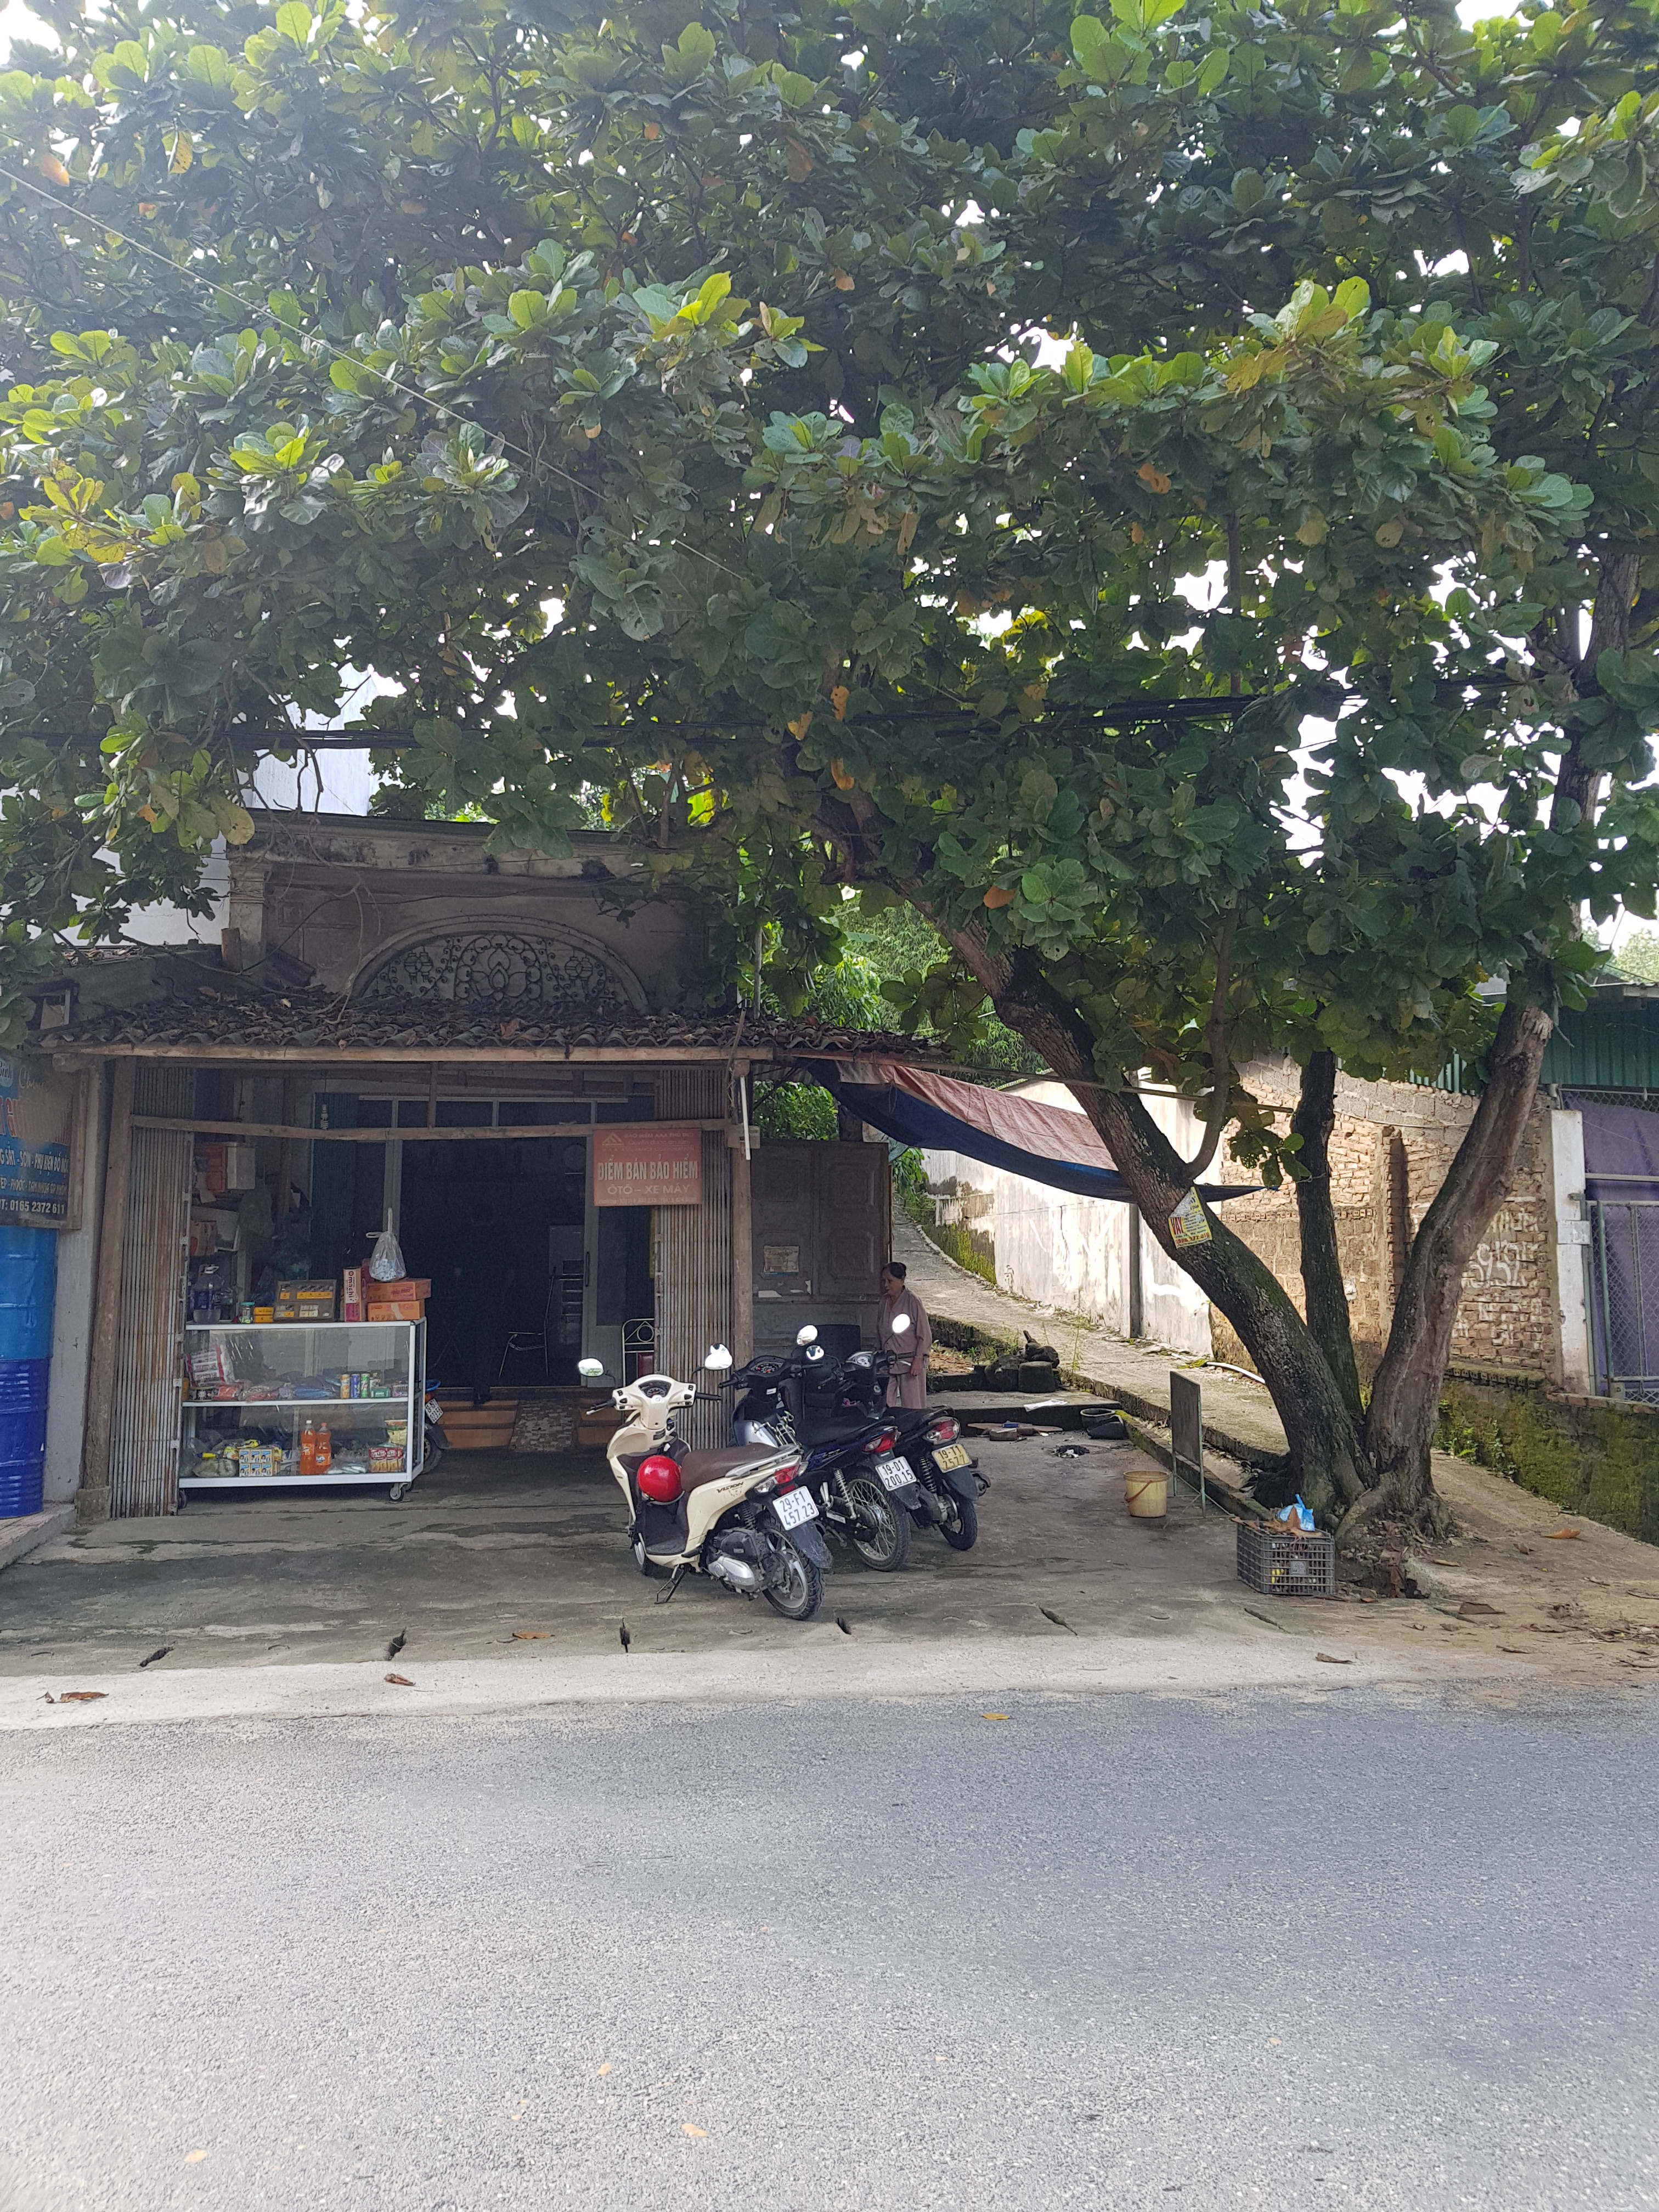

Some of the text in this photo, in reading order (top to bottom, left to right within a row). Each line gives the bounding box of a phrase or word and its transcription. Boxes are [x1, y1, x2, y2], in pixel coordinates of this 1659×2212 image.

[597, 1153, 698, 1180] ĐIỂM BÁN BẢO HIỂM
[607, 1182, 690, 1195] ÔTÔ XE MÁY
[10, 1199, 30, 1212] 0165
[31, 1201, 51, 1214] 2372
[52, 1203, 65, 1215] 611
[943, 1454, 965, 1469] 2577
[885, 1470, 913, 1488] 200.15
[785, 1503, 815, 1526] 457.23
